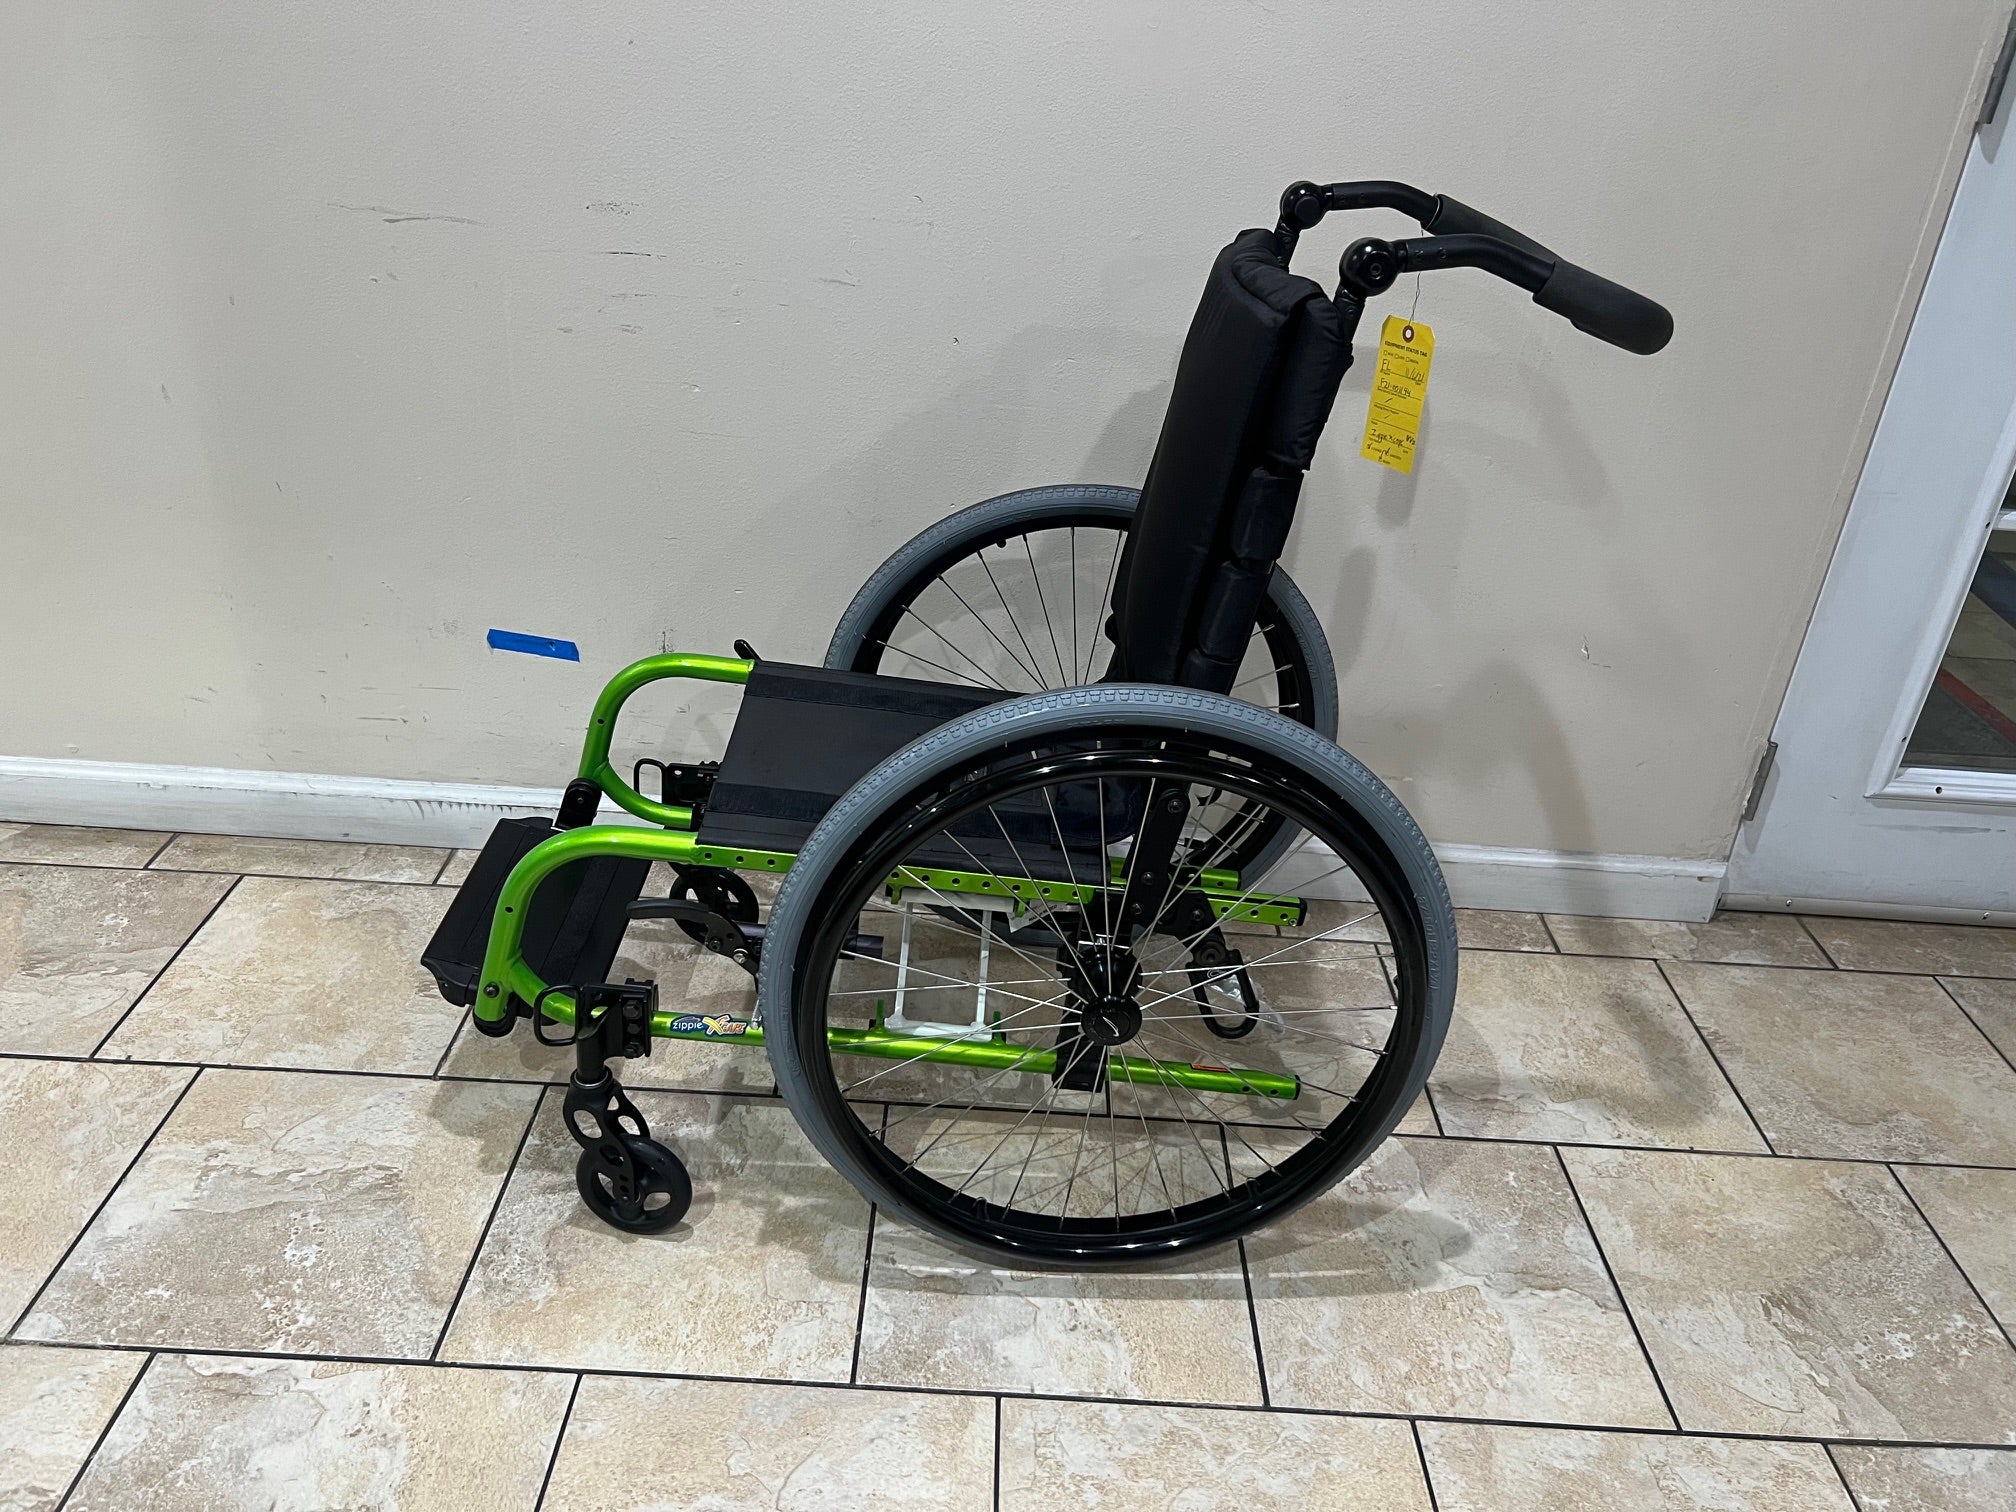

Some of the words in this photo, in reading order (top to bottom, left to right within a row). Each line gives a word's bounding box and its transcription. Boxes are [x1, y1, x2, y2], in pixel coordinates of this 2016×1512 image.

[1384, 340, 1406, 350] EQUIPMENT
[1405, 346, 1420, 355] STATUS
[1419, 350, 1428, 358] TAG
[672, 1021, 704, 1031] zippie
